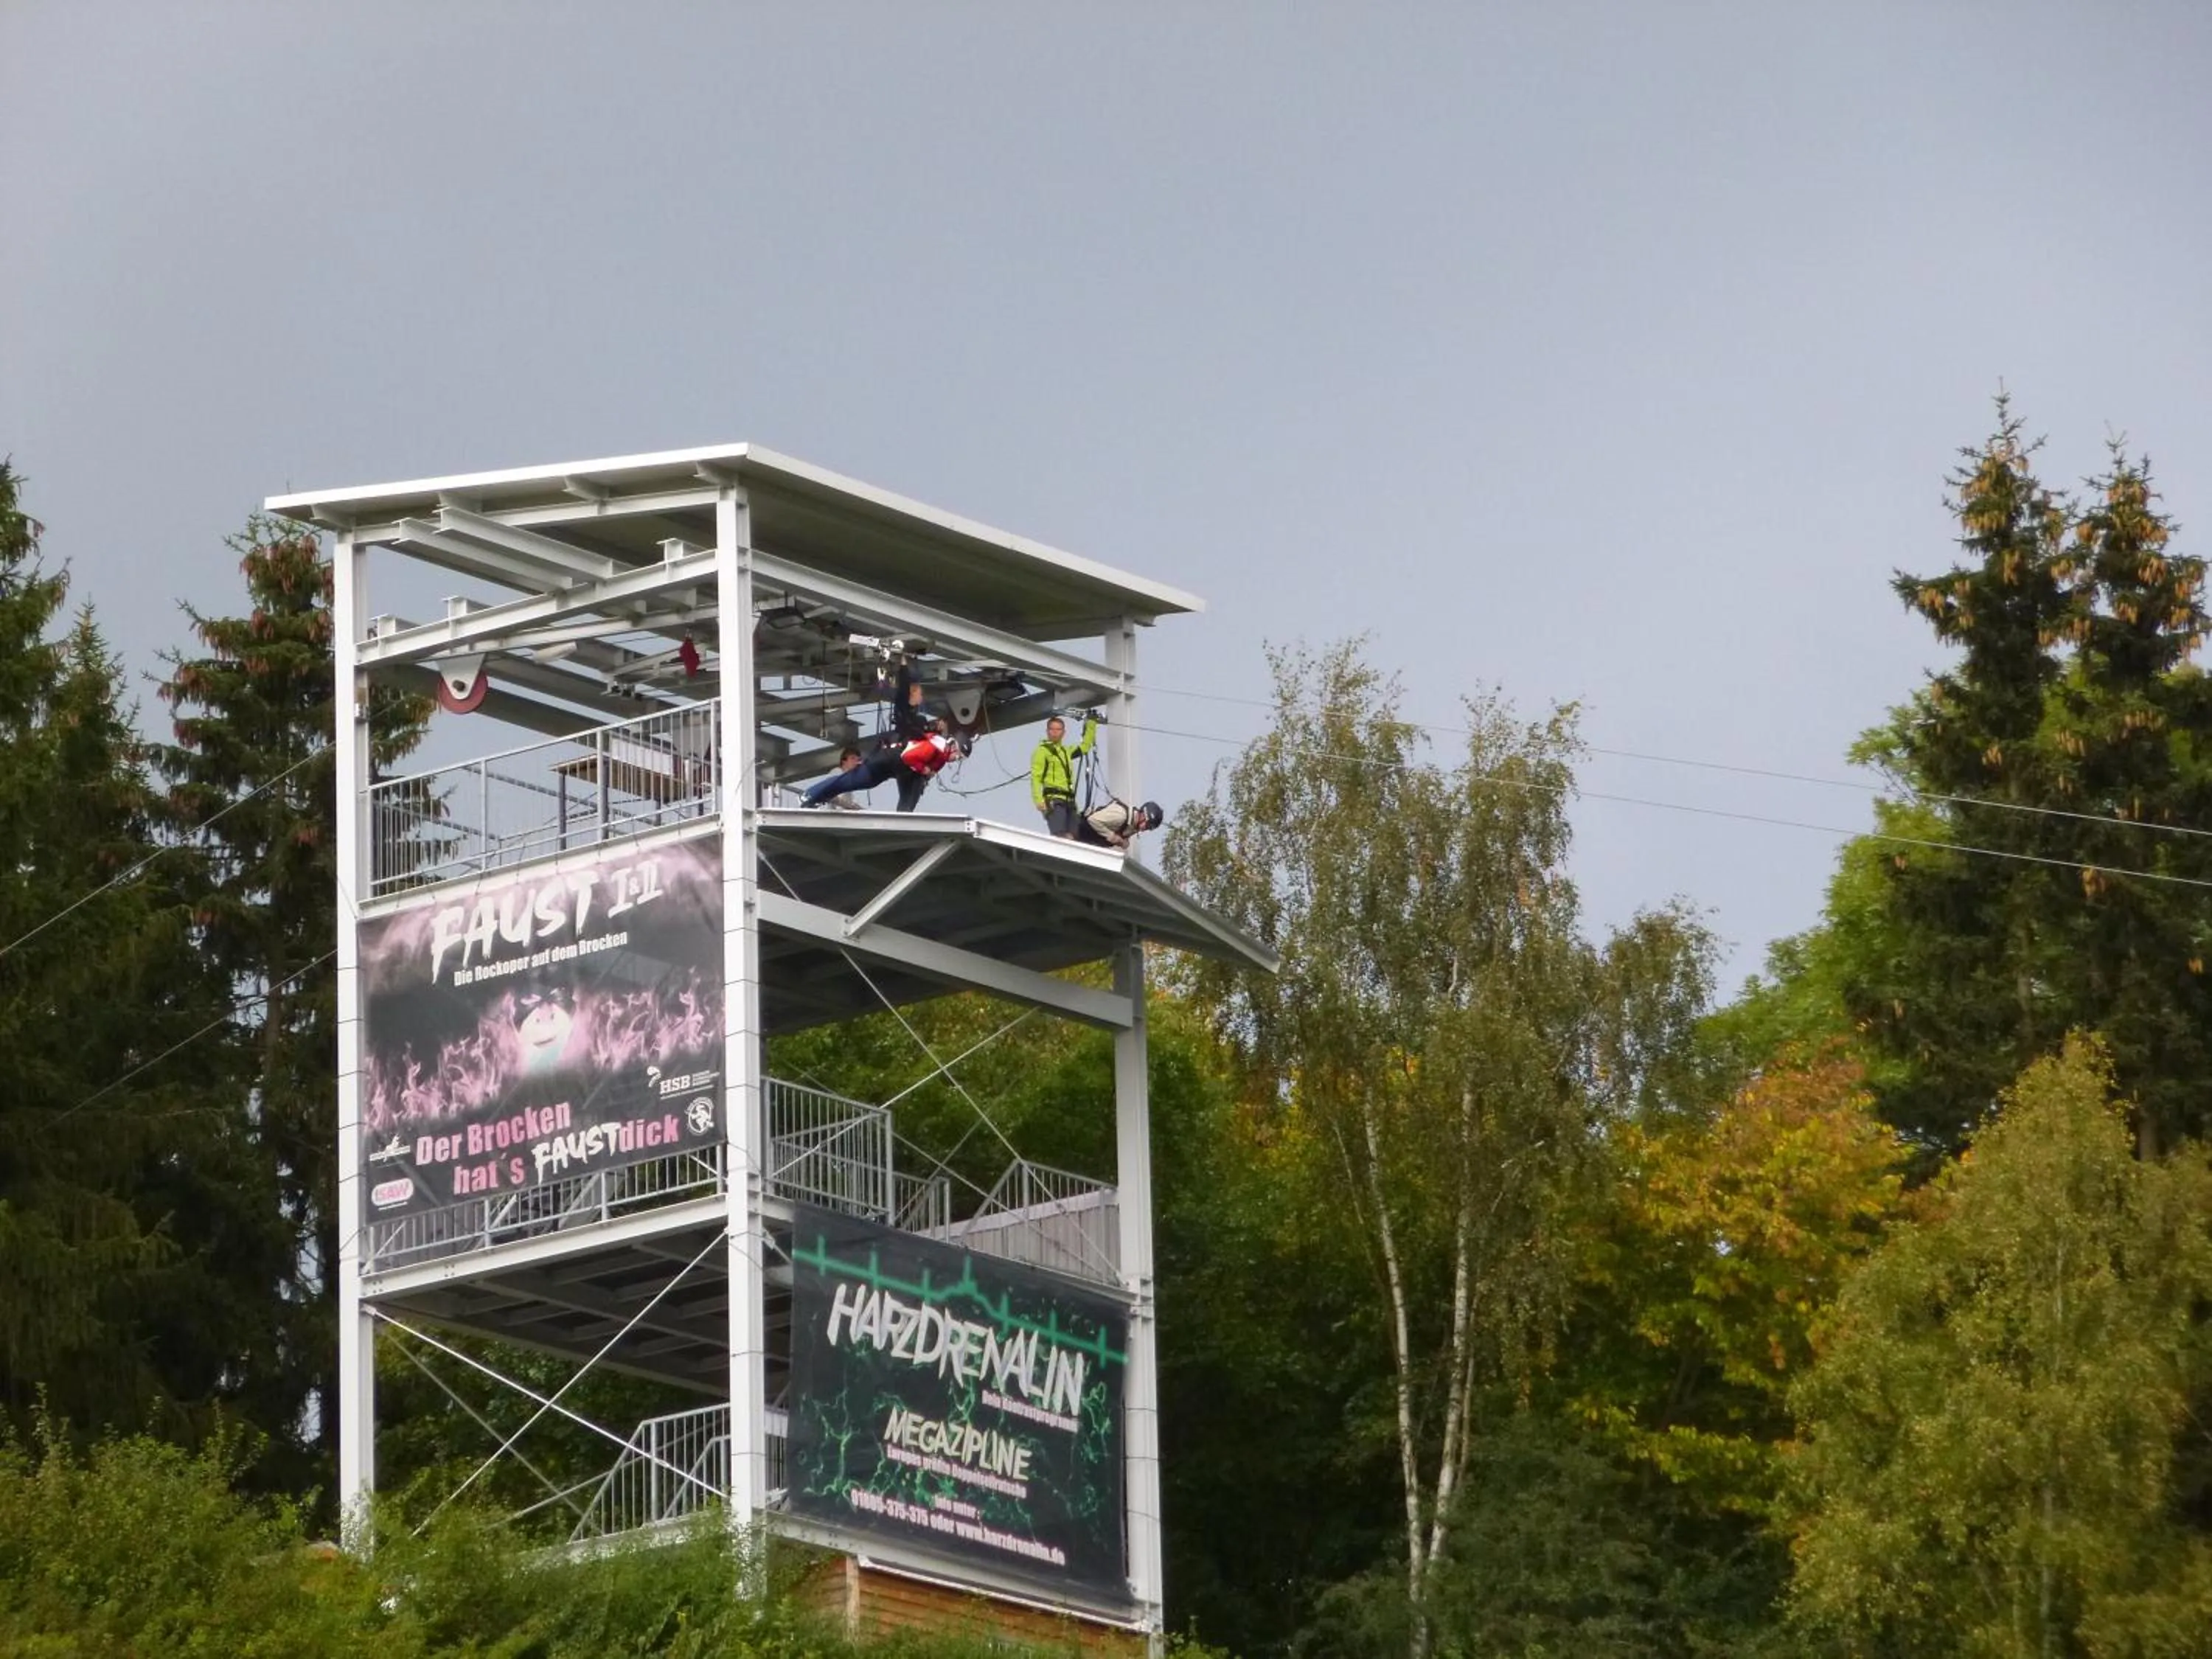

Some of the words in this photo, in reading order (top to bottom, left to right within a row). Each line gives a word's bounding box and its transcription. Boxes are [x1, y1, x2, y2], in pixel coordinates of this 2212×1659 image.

[431, 870, 599, 985] FAUST
[453, 968, 473, 987] Die
[475, 956, 529, 981] Rockoper
[531, 948, 550, 968] auf
[551, 945, 578, 963] dem
[578, 931, 627, 956] Brocken
[660, 1074, 691, 1095] HSB
[415, 1133, 462, 1166] Der
[467, 1102, 571, 1155] Brocken
[827, 1283, 1085, 1416] HARZDRENALIN
[883, 1405, 1033, 1482] MEGAZIPLINE
[930, 1514, 955, 1534] oder
